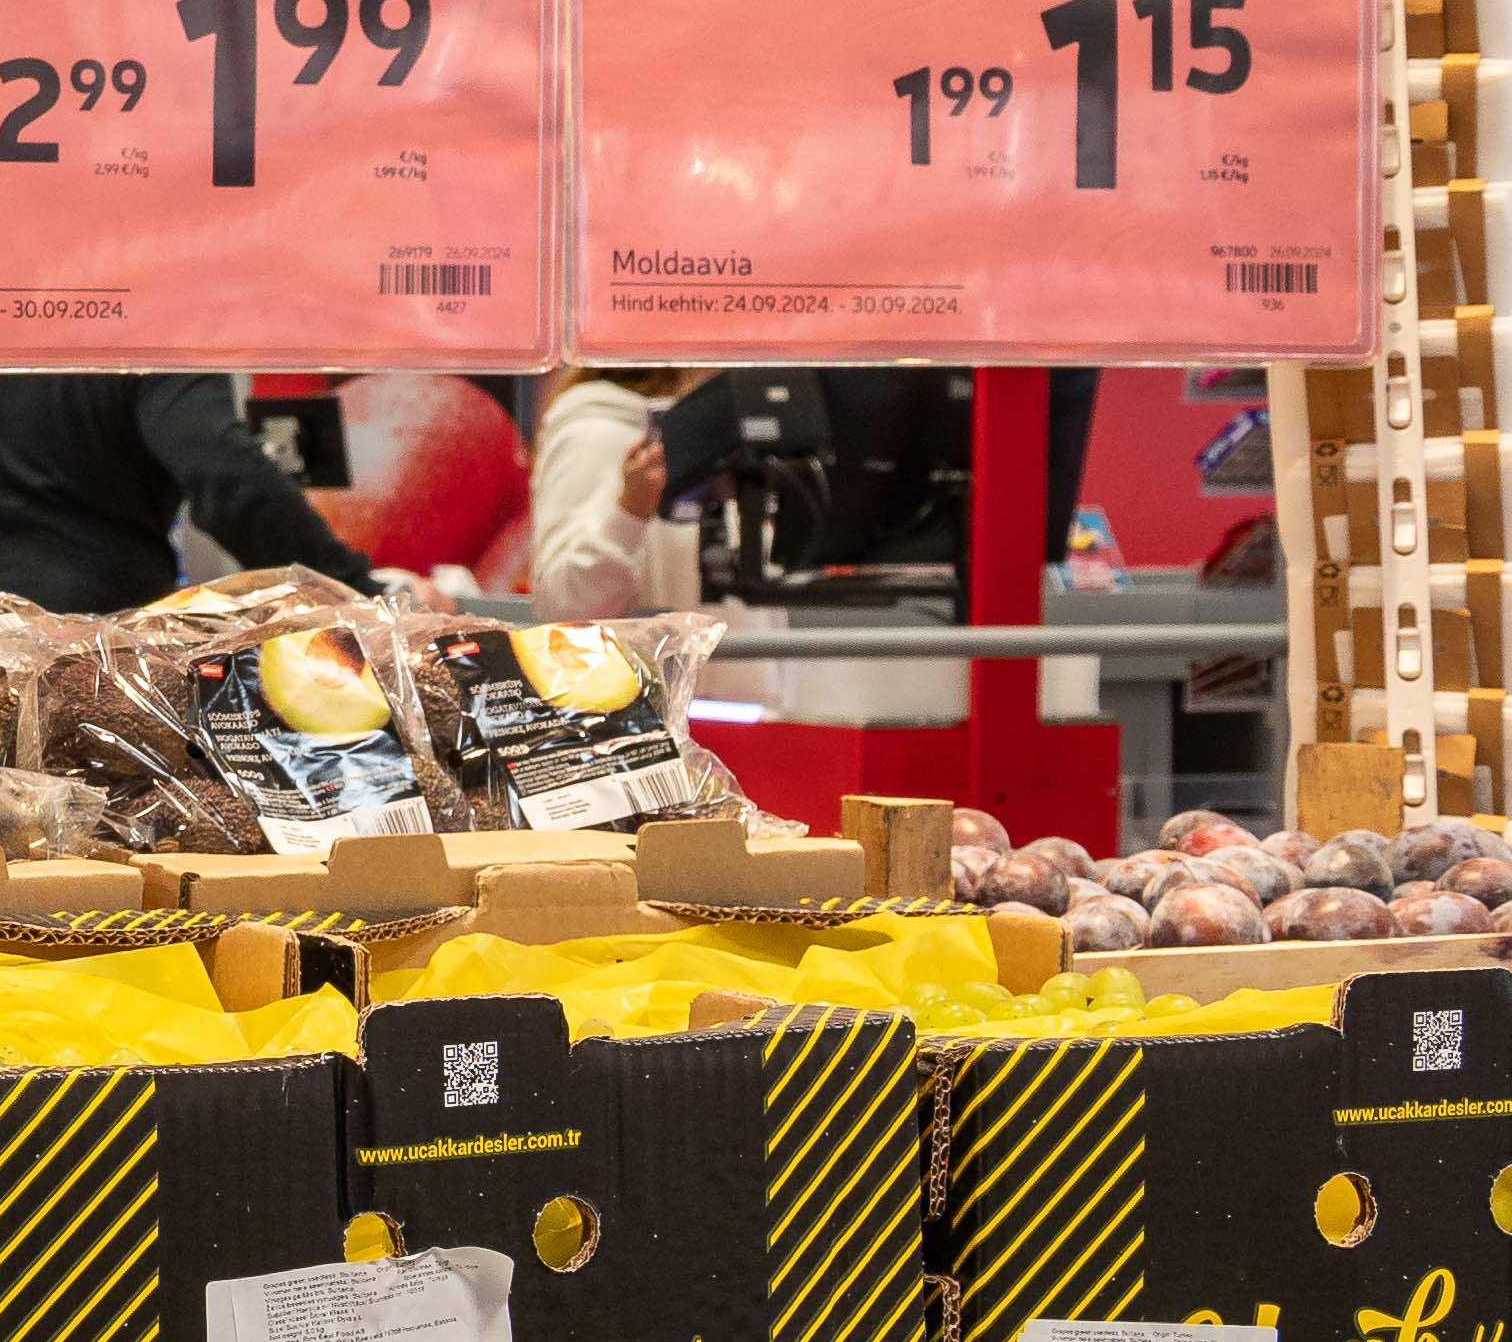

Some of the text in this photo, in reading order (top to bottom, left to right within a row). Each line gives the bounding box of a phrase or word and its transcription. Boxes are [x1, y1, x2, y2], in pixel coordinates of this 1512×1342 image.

[612, 249, 753, 277] Moldaavia
[12, 299, 128, 320] 30.09.2024.
[359, 1129, 581, 1166] www.ucakkardesler.com.tr
